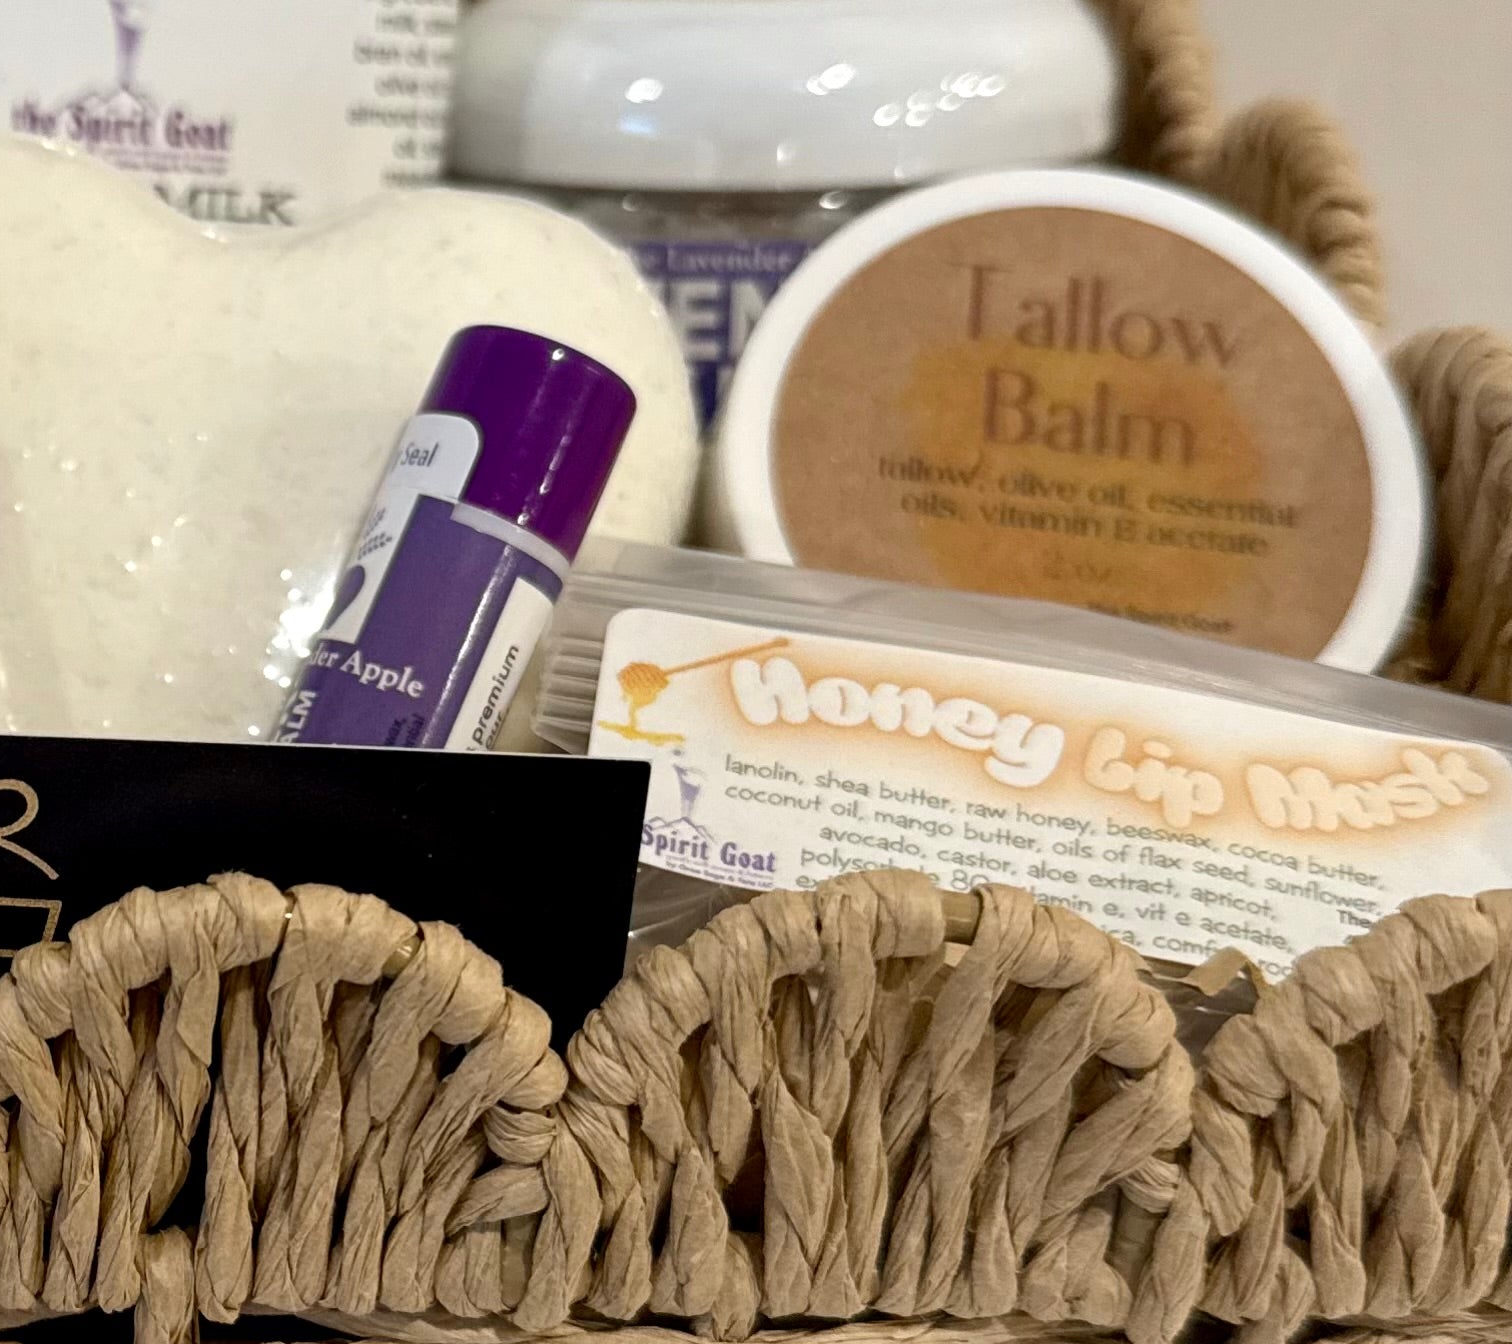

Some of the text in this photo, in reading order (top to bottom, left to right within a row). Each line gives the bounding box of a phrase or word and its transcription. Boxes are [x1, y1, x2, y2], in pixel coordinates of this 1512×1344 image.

[946, 262, 1245, 368] Tallow
[399, 441, 439, 467] Seal
[984, 365, 1196, 465] Balm
[980, 501, 1102, 538] vitamin
[1113, 517, 1136, 543] E
[339, 649, 425, 699] Apple
[471, 645, 519, 746] premium
[730, 657, 1489, 833] Honey Lip Mask
[641, 823, 710, 861] Spirit
[719, 841, 776, 872] Goat
[724, 753, 1387, 893] lanolin, shea butter, raw honey, beeswax, cocoa butter,
[724, 783, 1383, 917] coconut oil, mango butter, oils of flax seed, sunflower,
[819, 822, 1277, 922] avocado, castor, aloe extract, apricot,
[1102, 900, 1126, 920] e,
[1134, 900, 1168, 921] vit
[1175, 910, 1193, 927] e
[1199, 916, 1292, 953] acetate,
[1335, 908, 1374, 929] The
